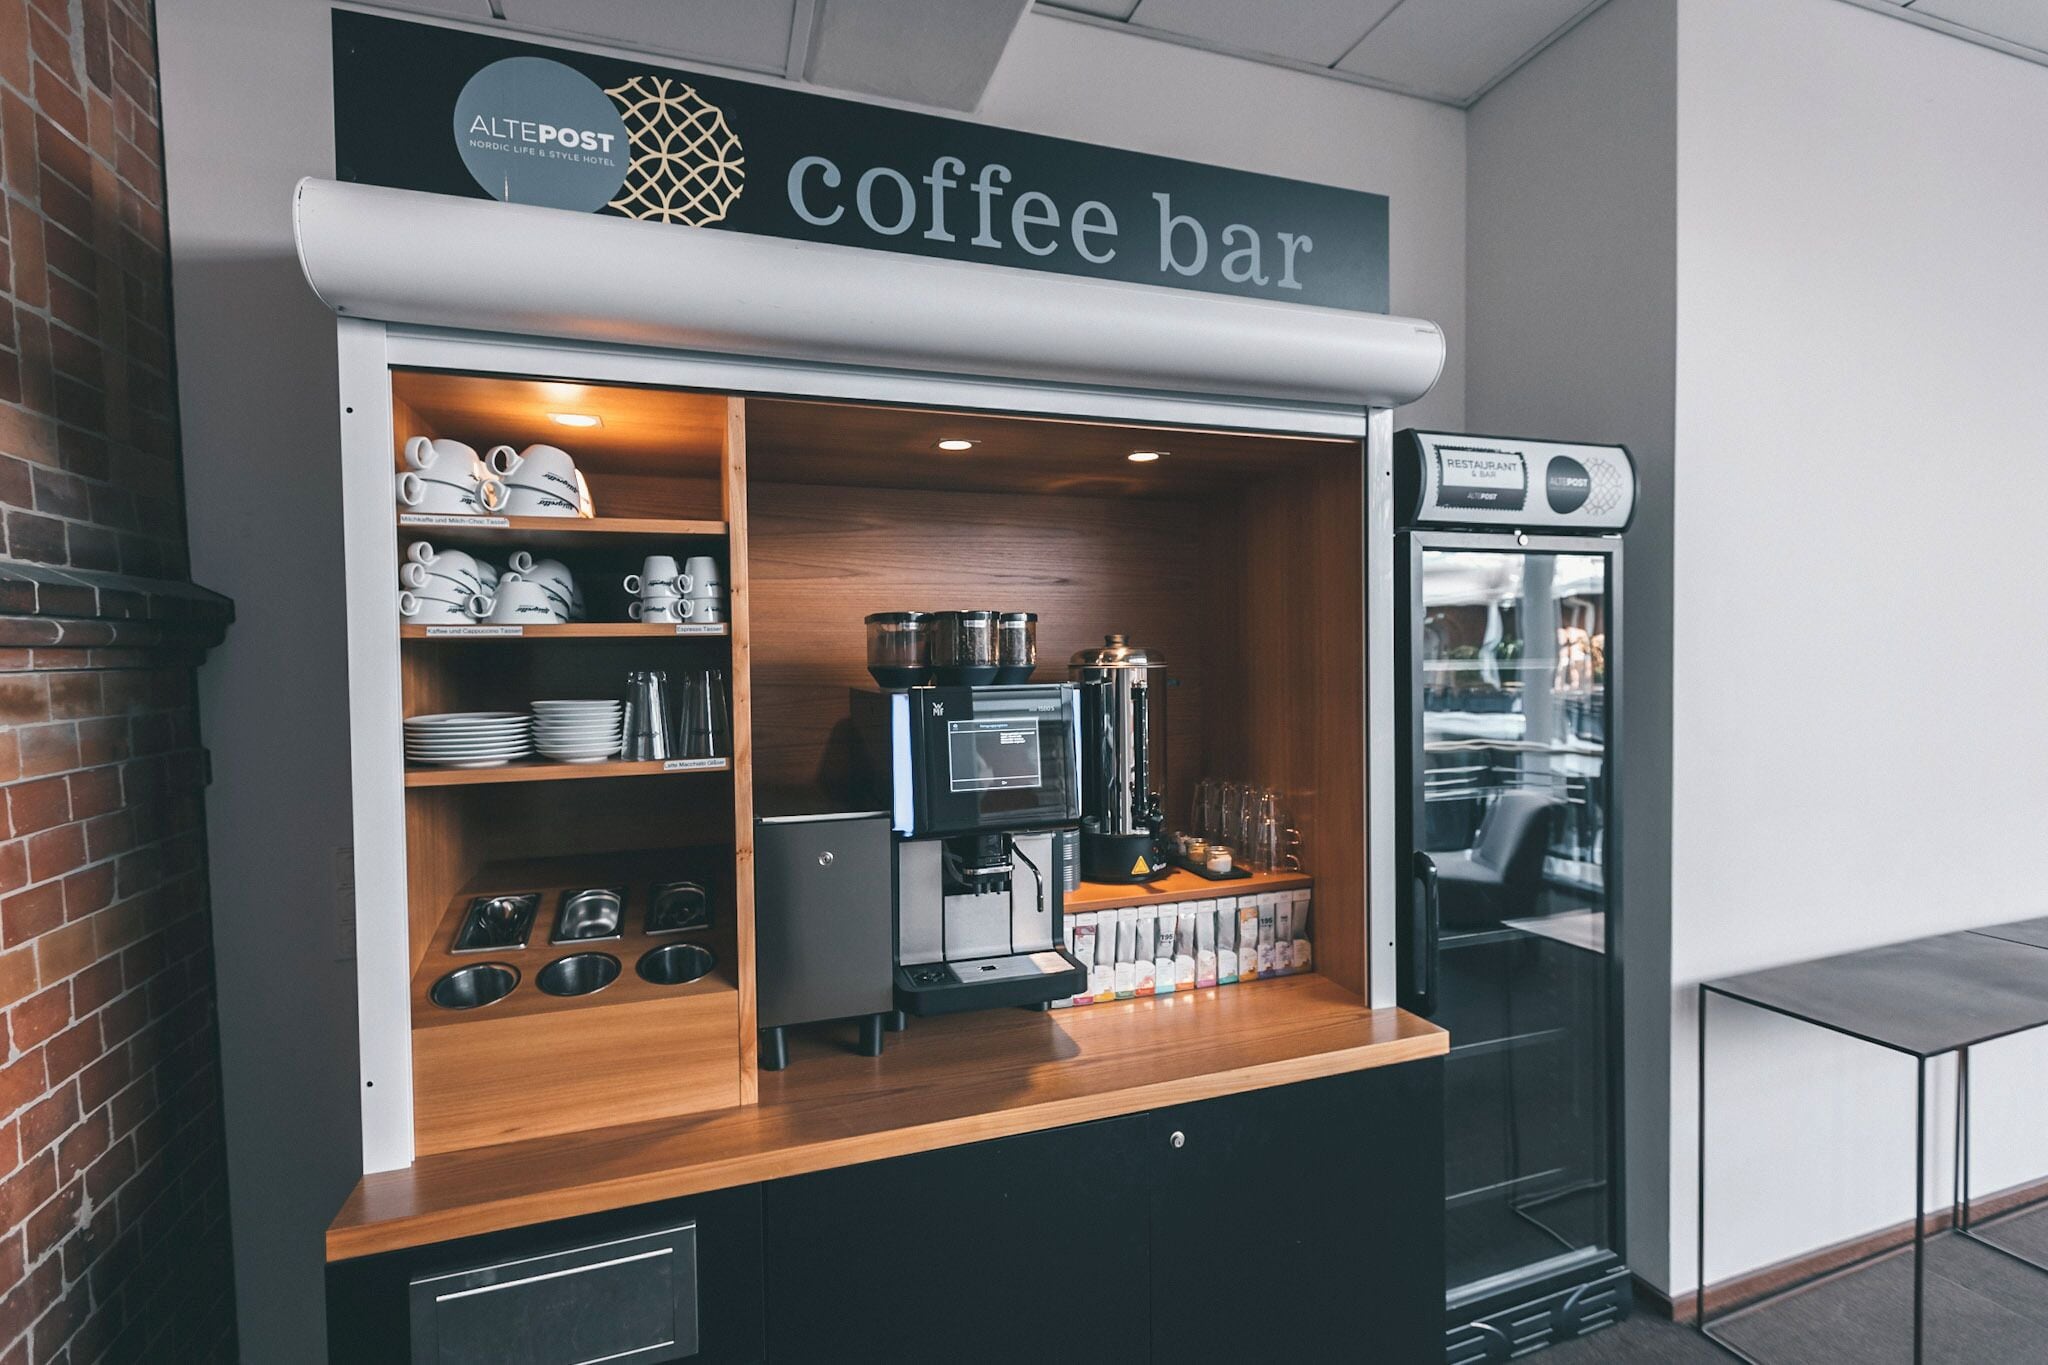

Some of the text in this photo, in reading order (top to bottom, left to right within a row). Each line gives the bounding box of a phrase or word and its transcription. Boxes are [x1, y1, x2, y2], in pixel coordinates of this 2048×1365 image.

[469, 114, 615, 153] ALTEPOST
[469, 139, 510, 152] NORDIC
[513, 146, 535, 156] LIFE
[549, 151, 581, 162] STYLE
[583, 156, 616, 167] HOTEL
[786, 155, 1314, 291] coffee bar
[1447, 459, 1518, 471] RESTAURANT
[1550, 477, 1588, 487] ALTEPOST
